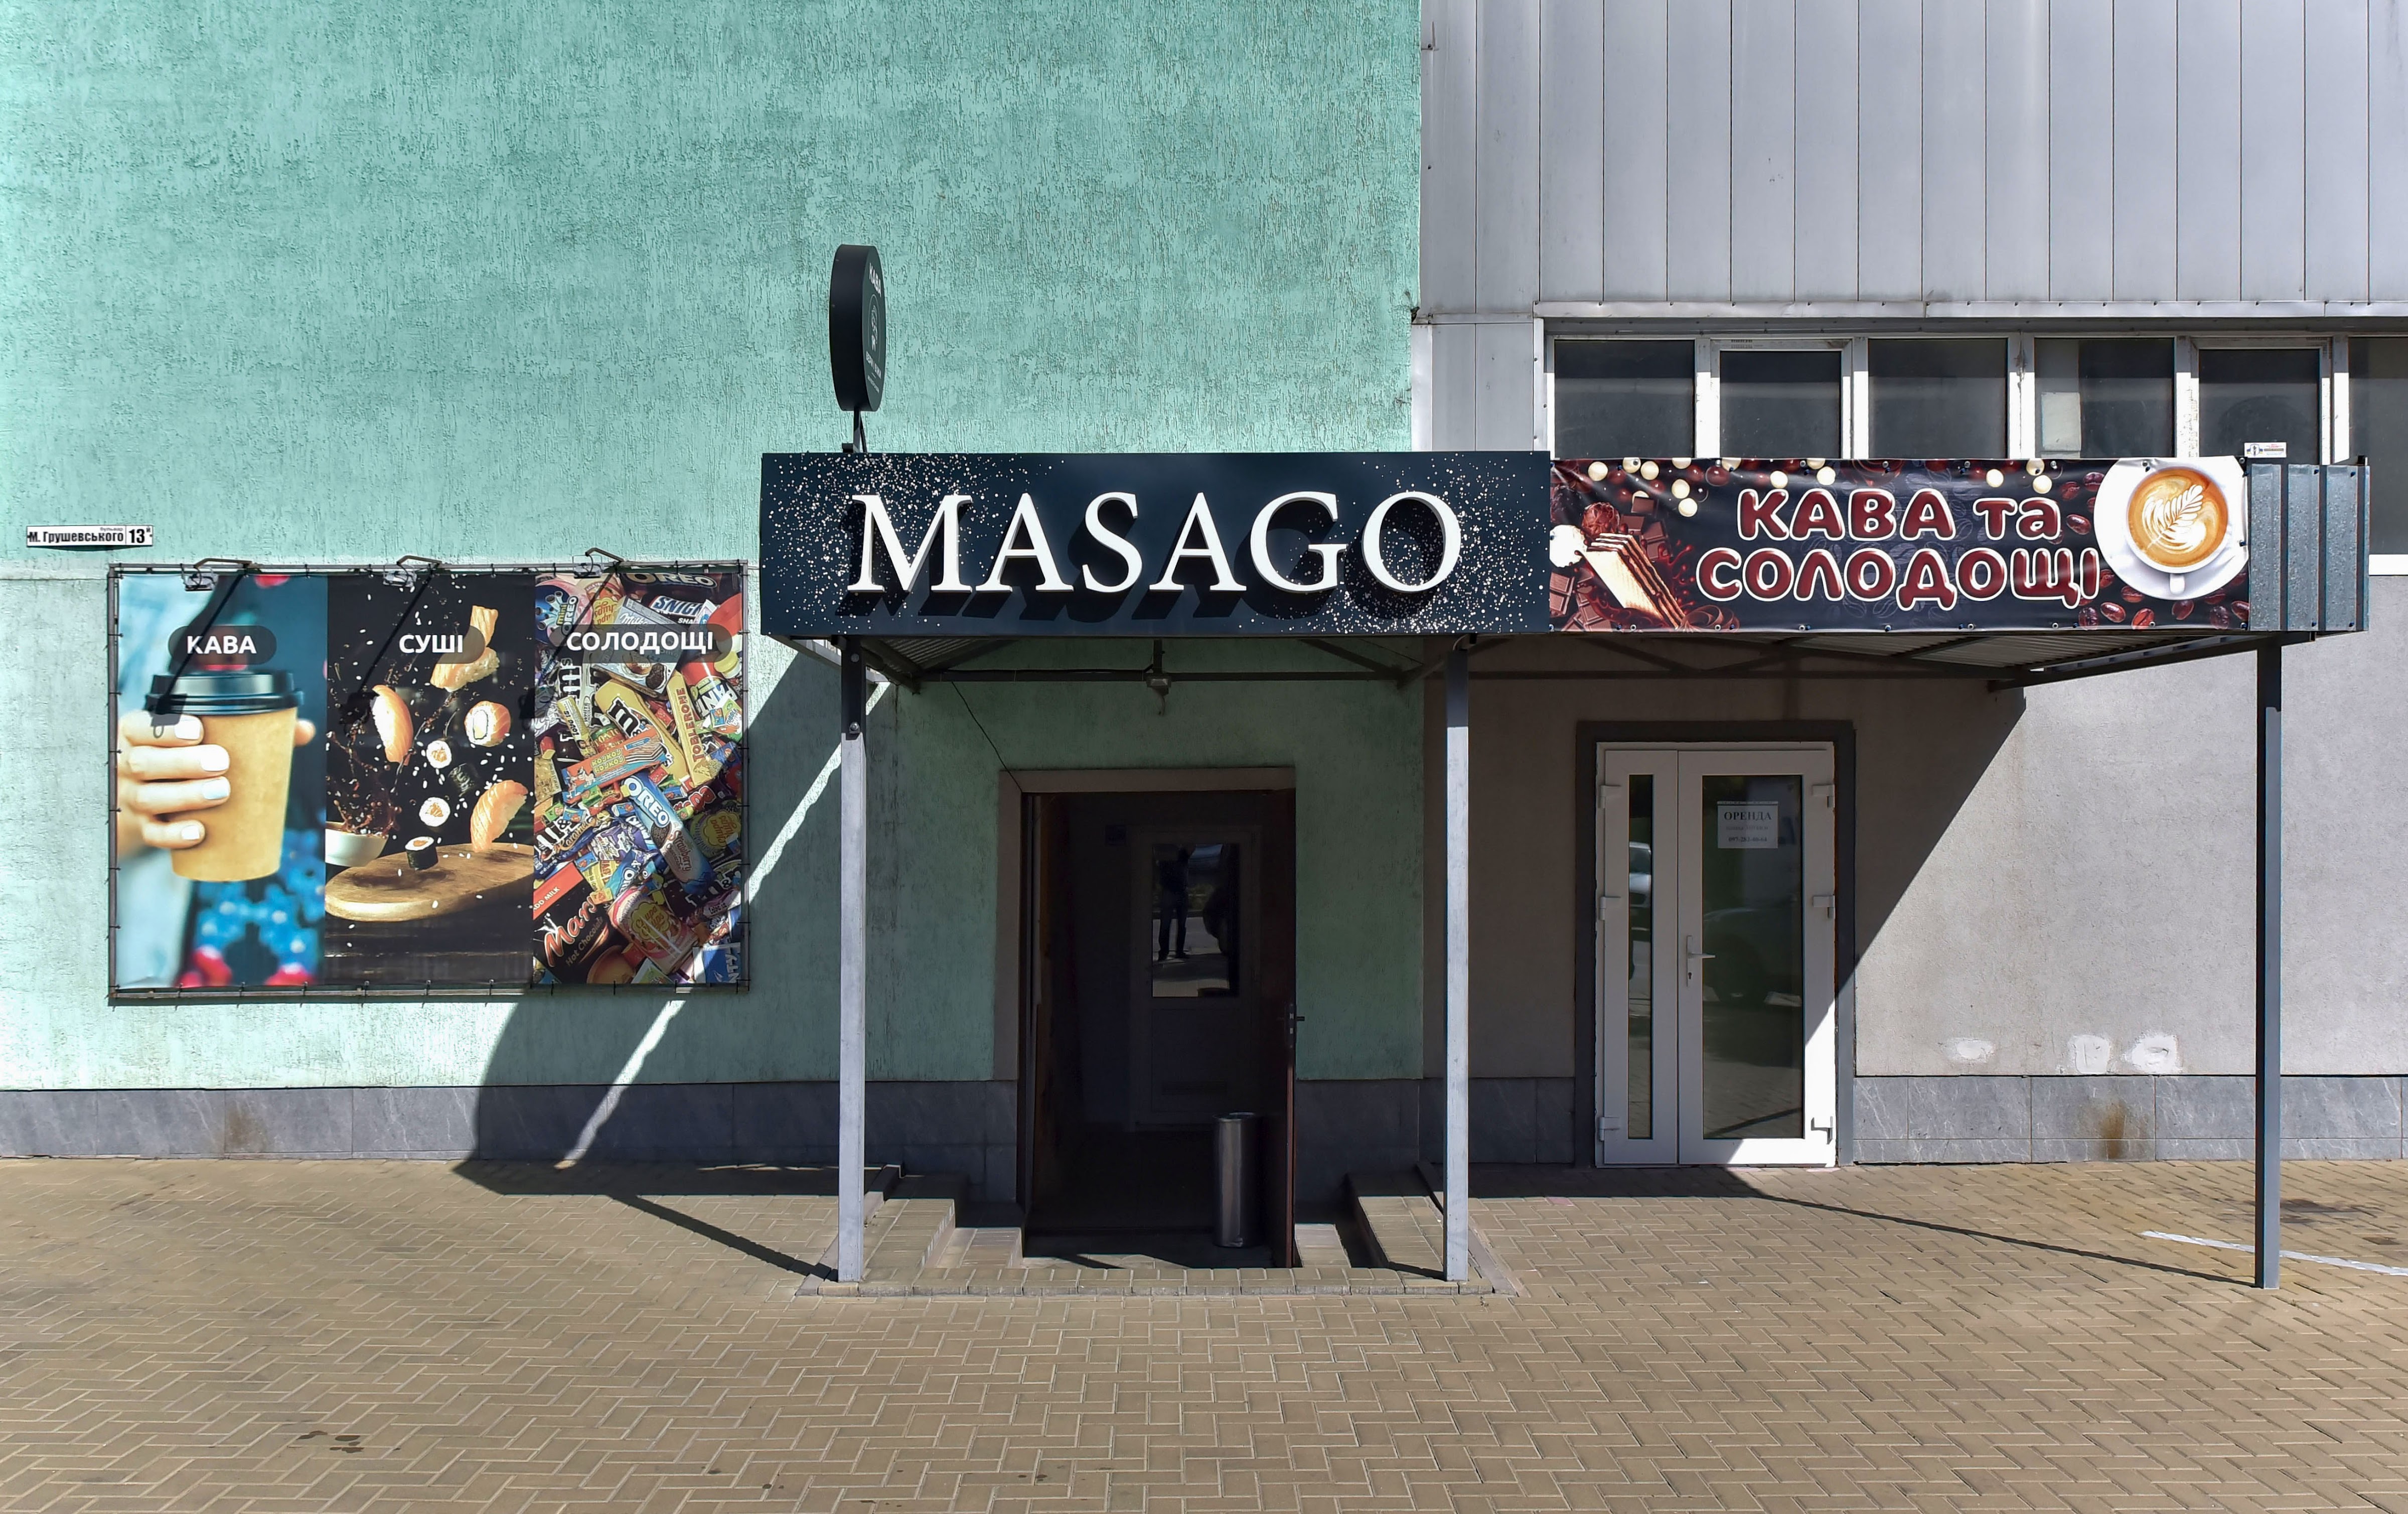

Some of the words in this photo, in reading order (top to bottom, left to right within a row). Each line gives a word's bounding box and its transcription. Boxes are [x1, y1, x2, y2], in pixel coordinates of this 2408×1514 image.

[1737, 488, 1957, 541] КАВА
[1974, 497, 2061, 539] та
[29, 532, 41, 542] М.
[43, 532, 124, 543] Грушевського
[850, 491, 1462, 593] MASAGO
[1697, 546, 2098, 611] СОЛОДОЩІ
[187, 635, 256, 654] КАВА
[399, 635, 463, 653] СУШІ
[566, 632, 713, 654] СОЛОДОЩІ
[676, 687, 705, 762] TOBLERONE
[625, 776, 669, 826] OREO
[1724, 811, 1772, 821] ОРЕНДА
[668, 830, 692, 872] Strawberry
[544, 886, 560, 901] MILK
[544, 896, 597, 968] Mars
[565, 949, 579, 967] Hot
